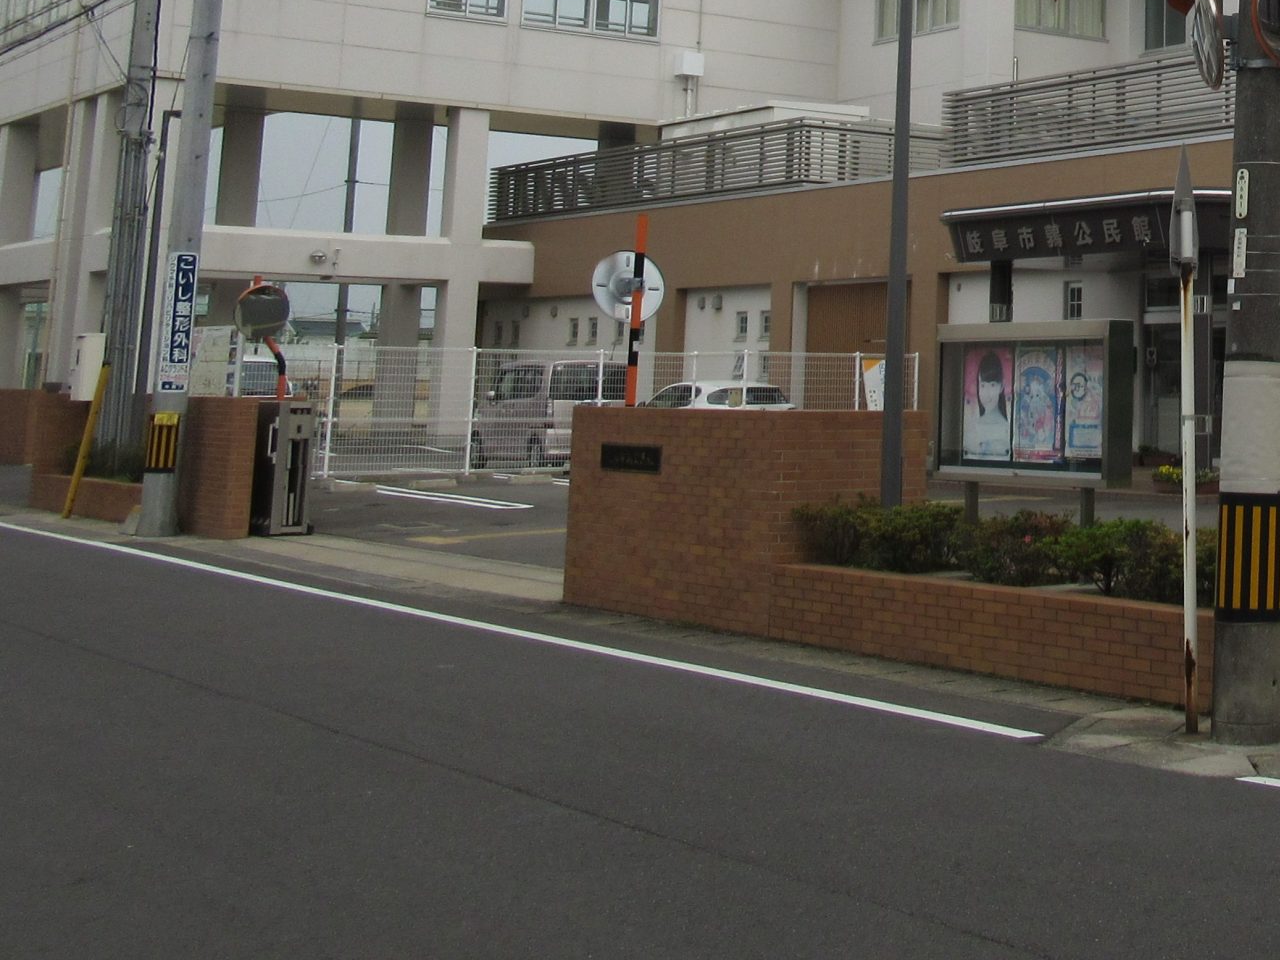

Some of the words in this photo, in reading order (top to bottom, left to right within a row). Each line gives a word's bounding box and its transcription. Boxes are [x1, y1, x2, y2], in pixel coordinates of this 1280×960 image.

[172, 255, 194, 362] こいし整形外科
